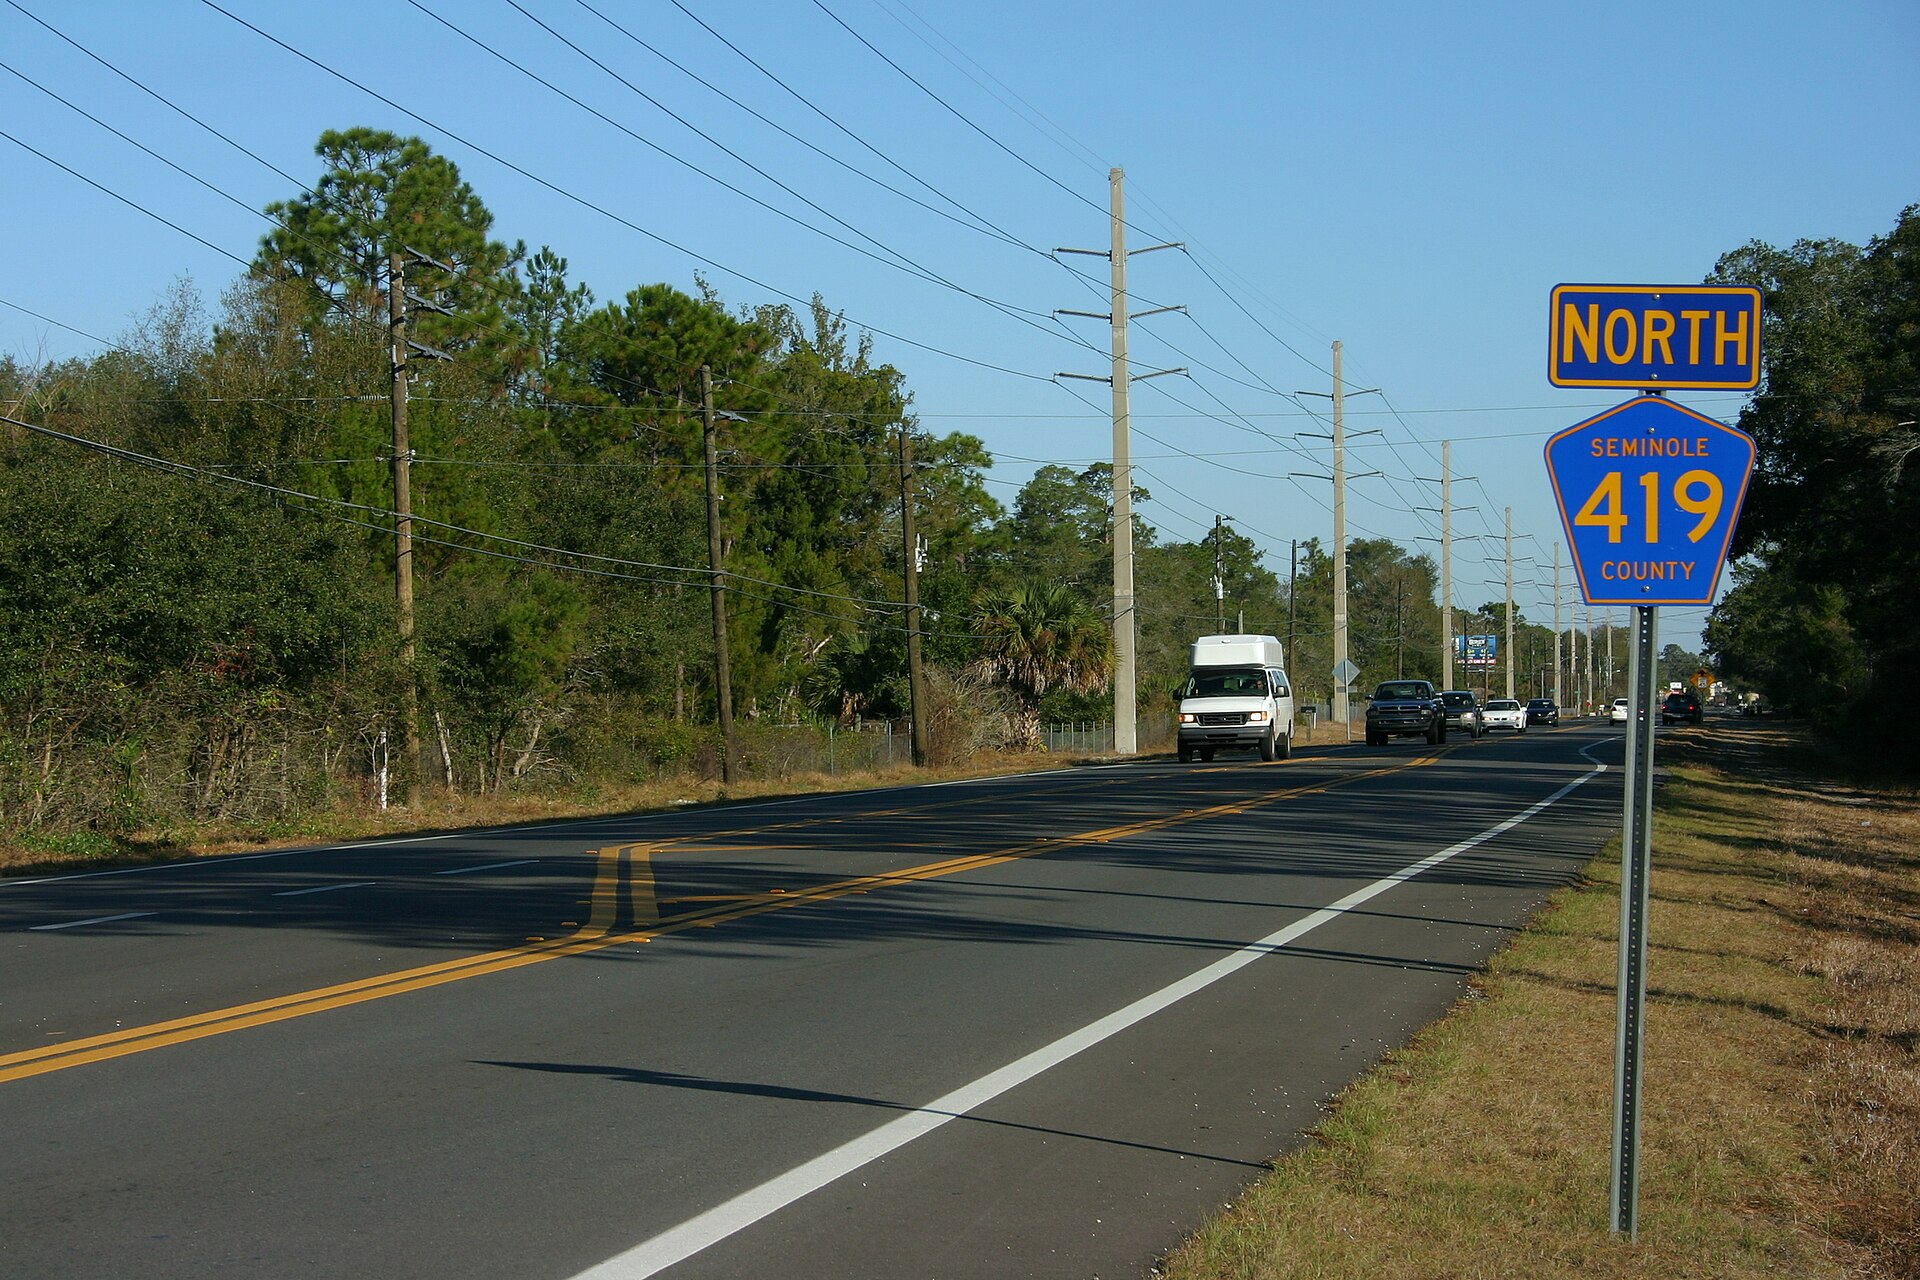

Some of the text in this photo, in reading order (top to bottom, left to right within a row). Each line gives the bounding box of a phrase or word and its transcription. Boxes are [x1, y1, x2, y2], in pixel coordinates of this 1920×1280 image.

[1564, 303, 1747, 366] NORTH
[1591, 437, 1709, 458] SEMINOLE
[1574, 469, 1724, 545] 419
[1601, 561, 1695, 580] COUNTY
